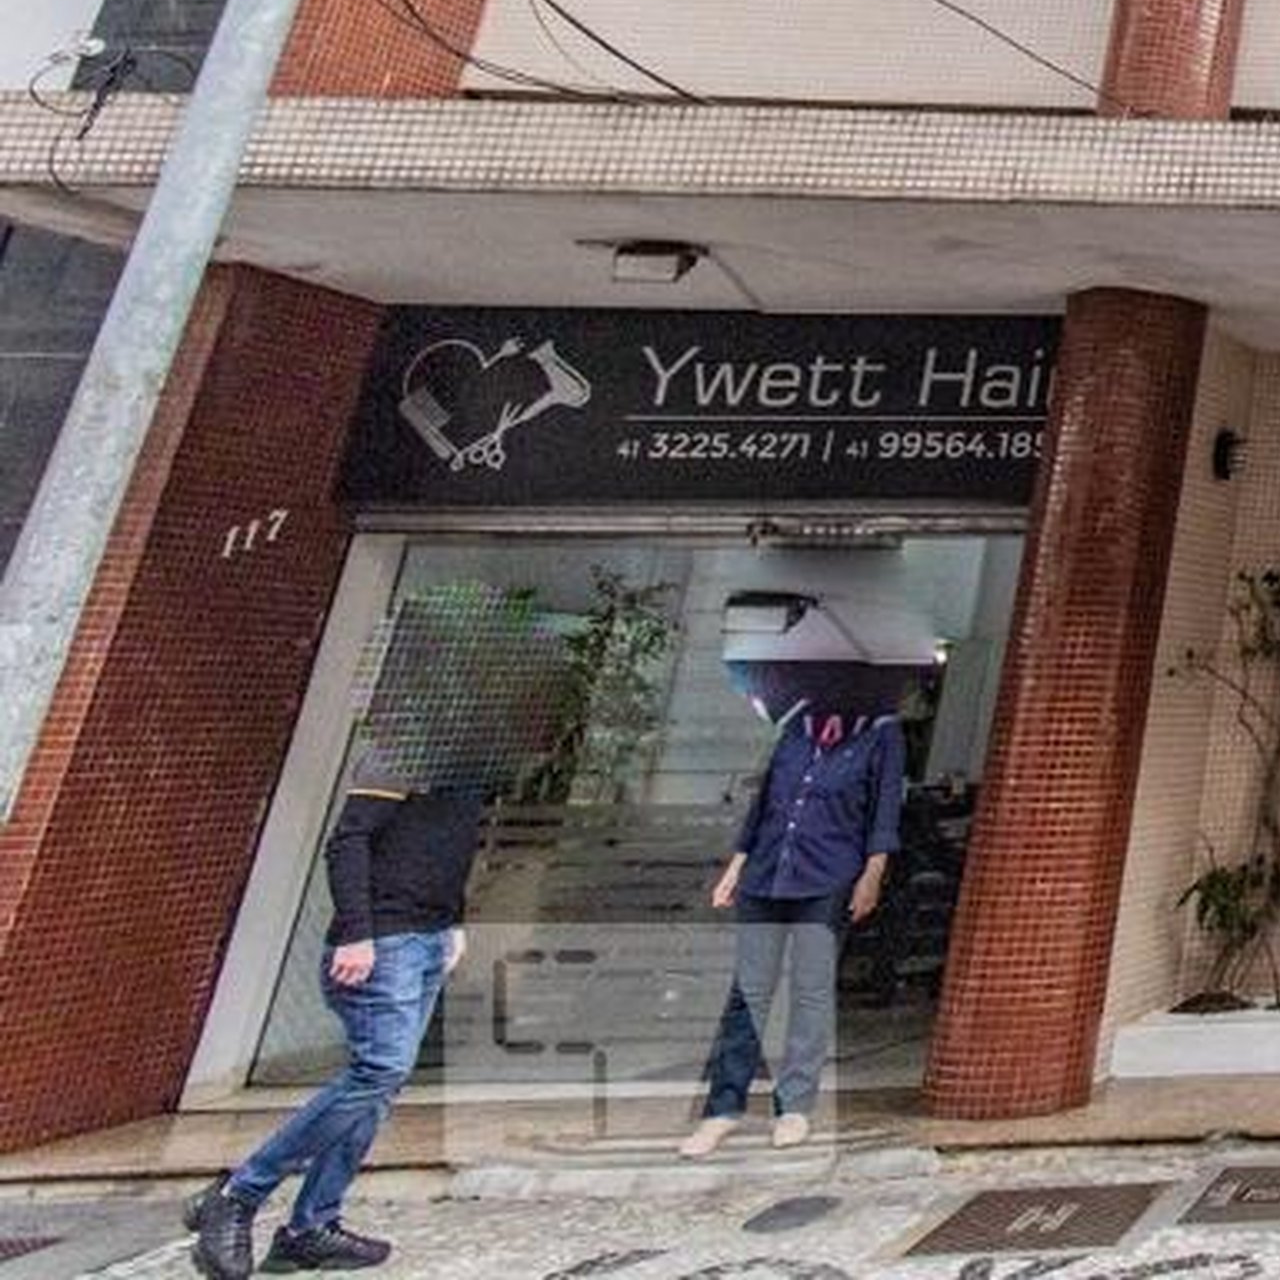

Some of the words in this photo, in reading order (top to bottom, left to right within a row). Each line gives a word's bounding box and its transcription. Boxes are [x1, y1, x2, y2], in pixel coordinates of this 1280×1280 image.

[642, 344, 887, 409] Ywett
[616, 439, 641, 460] 41
[648, 431, 812, 460] 3225.4271
[845, 439, 869, 460] 41
[221, 507, 290, 559] 117
